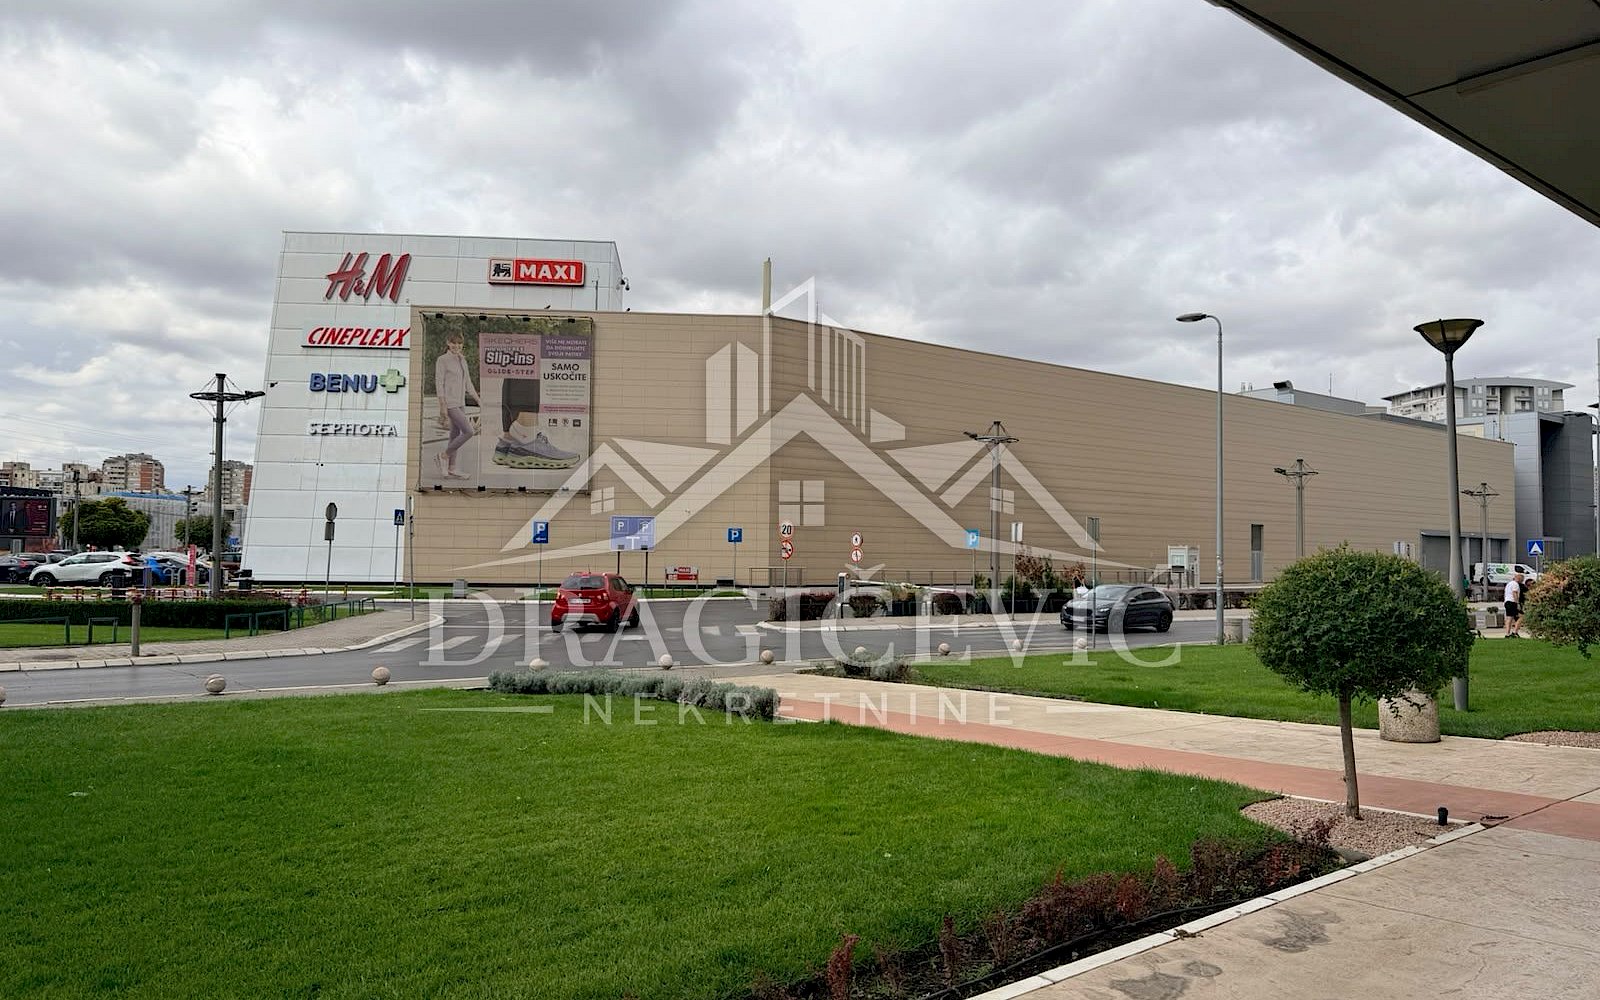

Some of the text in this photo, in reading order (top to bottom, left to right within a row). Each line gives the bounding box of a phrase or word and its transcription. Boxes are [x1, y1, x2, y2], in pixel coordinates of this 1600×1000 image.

[325, 252, 412, 304] H&M
[519, 263, 577, 280] MAXI
[307, 327, 411, 347] CINEPLEXX
[485, 351, 535, 367] Slip-ins
[551, 362, 580, 371] SAMO
[543, 371, 587, 381] USKOČITE
[309, 372, 378, 394] BENU
[309, 423, 398, 437] SEPHORA
[536, 522, 546, 534] P
[617, 521, 625, 531] P
[781, 524, 792, 535] 20
[731, 530, 740, 540] P
